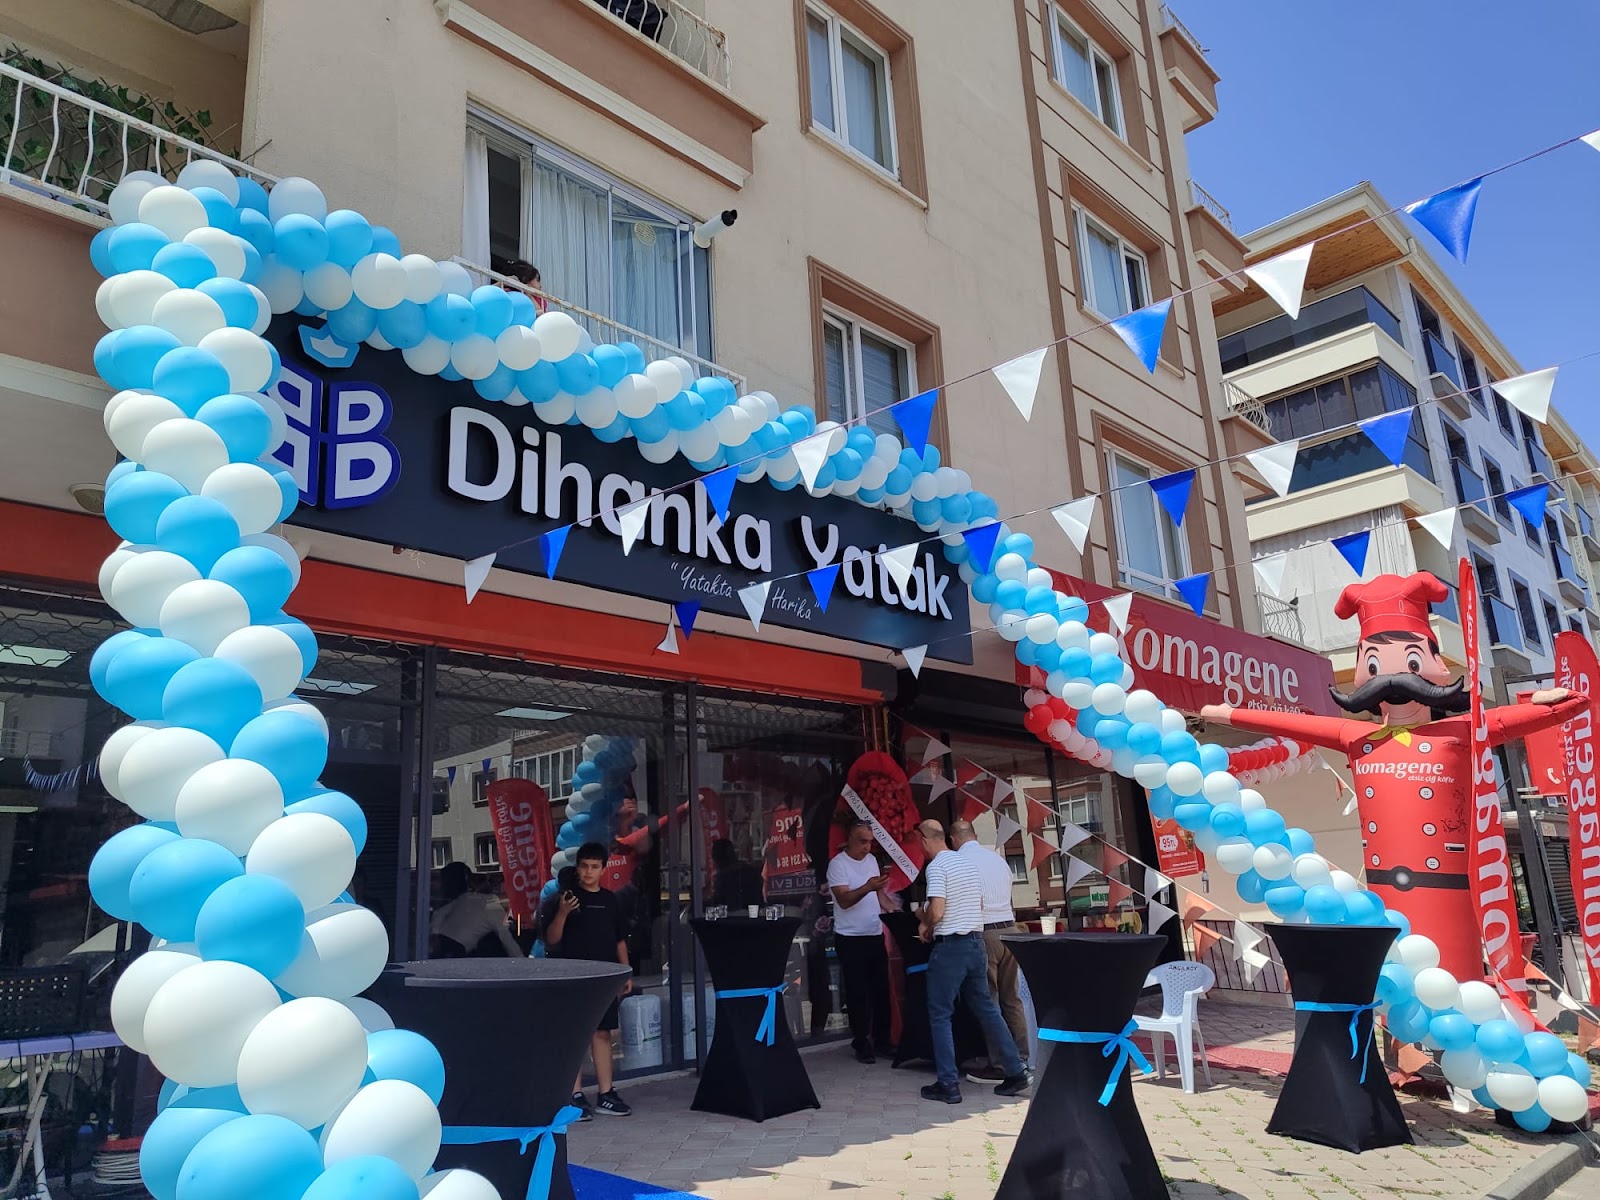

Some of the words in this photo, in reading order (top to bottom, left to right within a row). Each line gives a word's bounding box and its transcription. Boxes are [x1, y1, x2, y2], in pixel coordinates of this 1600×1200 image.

[448, 406, 772, 573] Dihanka
[799, 515, 954, 621] Yatak
[1355, 759, 1444, 779] komagene
[1437, 775, 1455, 784] köfte
